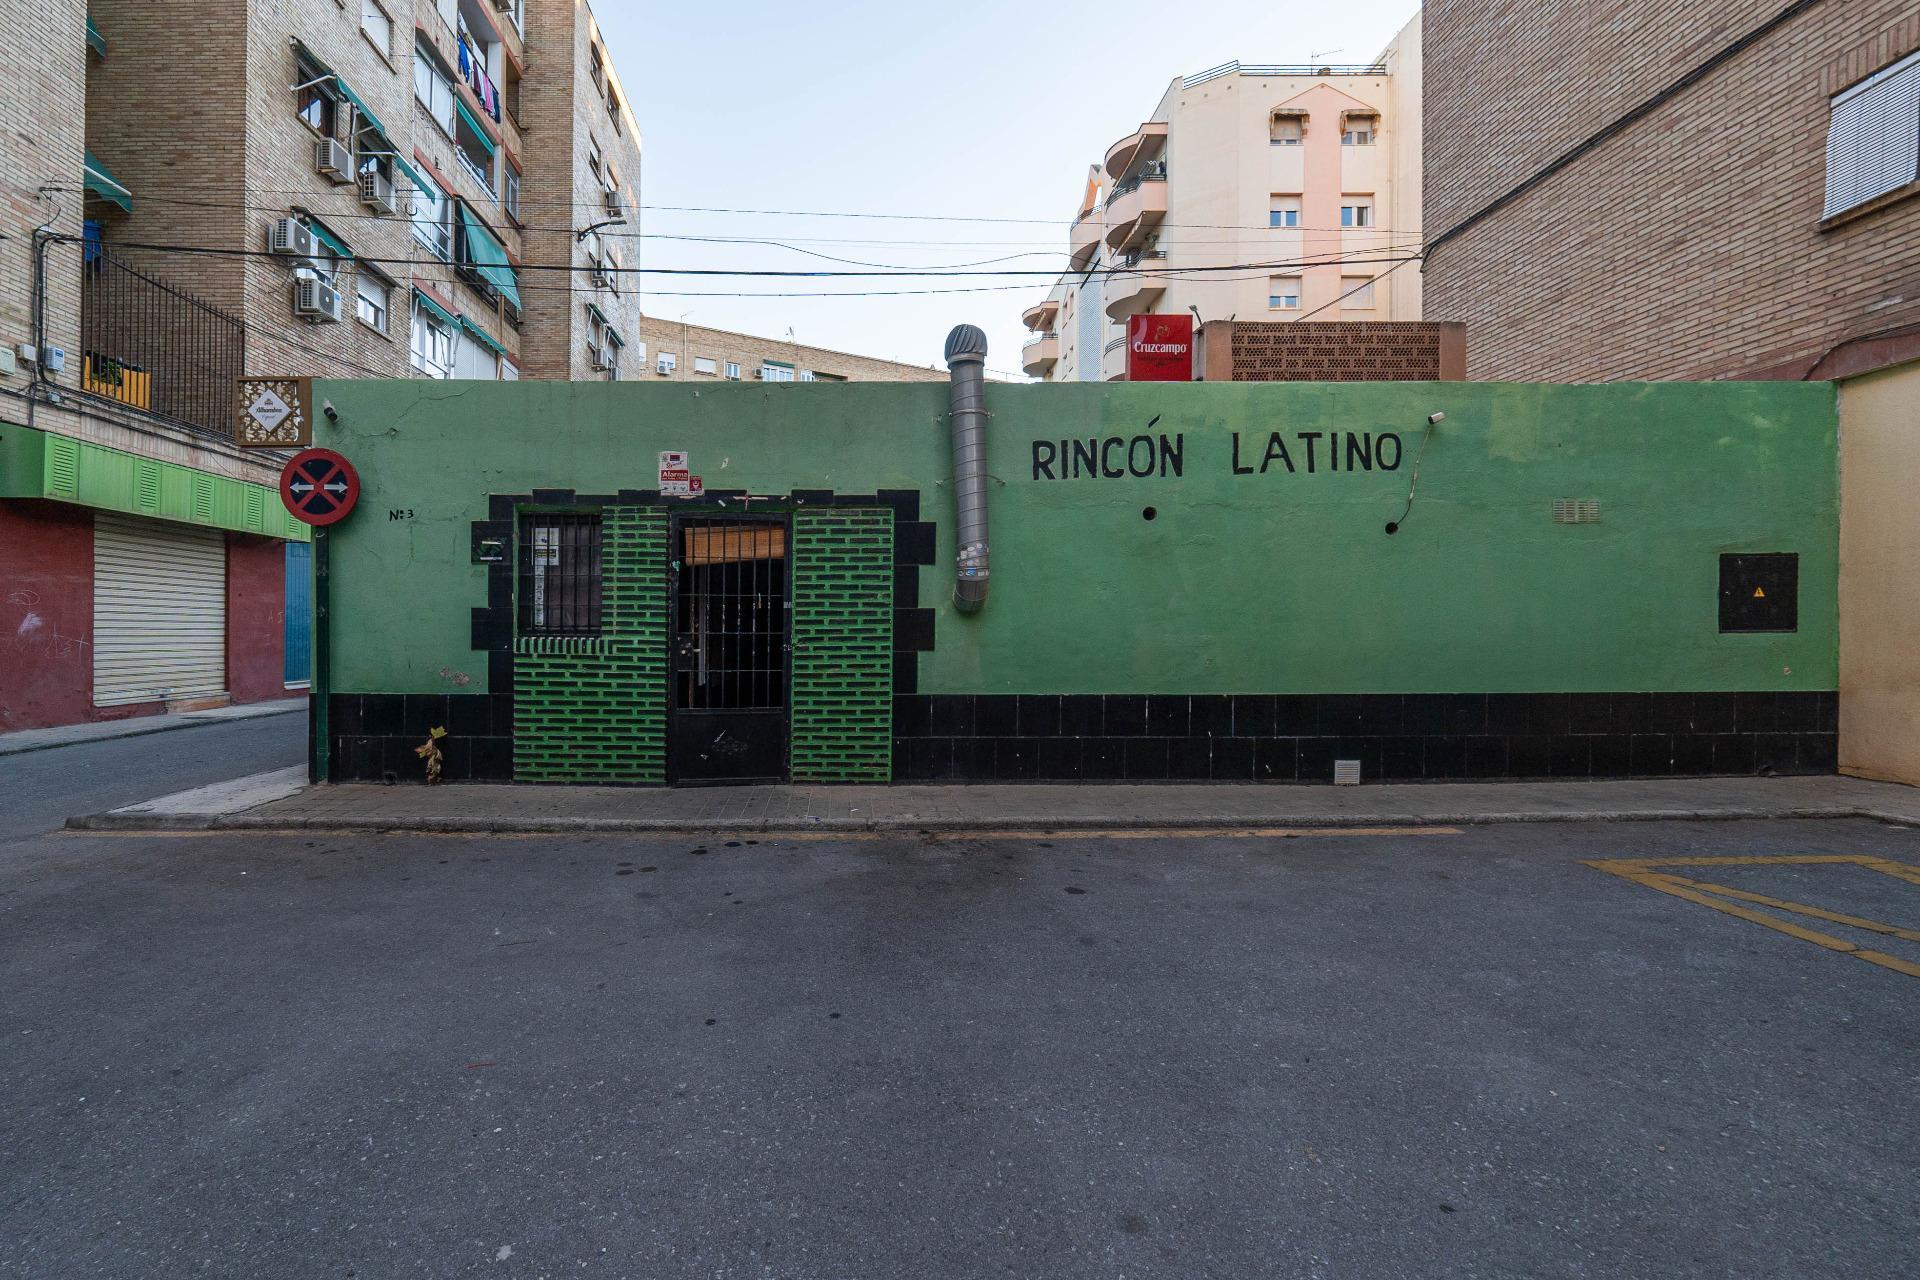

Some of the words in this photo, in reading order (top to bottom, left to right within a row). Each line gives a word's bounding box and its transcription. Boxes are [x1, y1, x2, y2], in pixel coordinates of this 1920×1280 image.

[1134, 341, 1187, 355] Cruzcampo
[1032, 414, 1184, 480] RINCÓN
[1232, 431, 1402, 475] LATINO
[407, 509, 414, 518] 3
